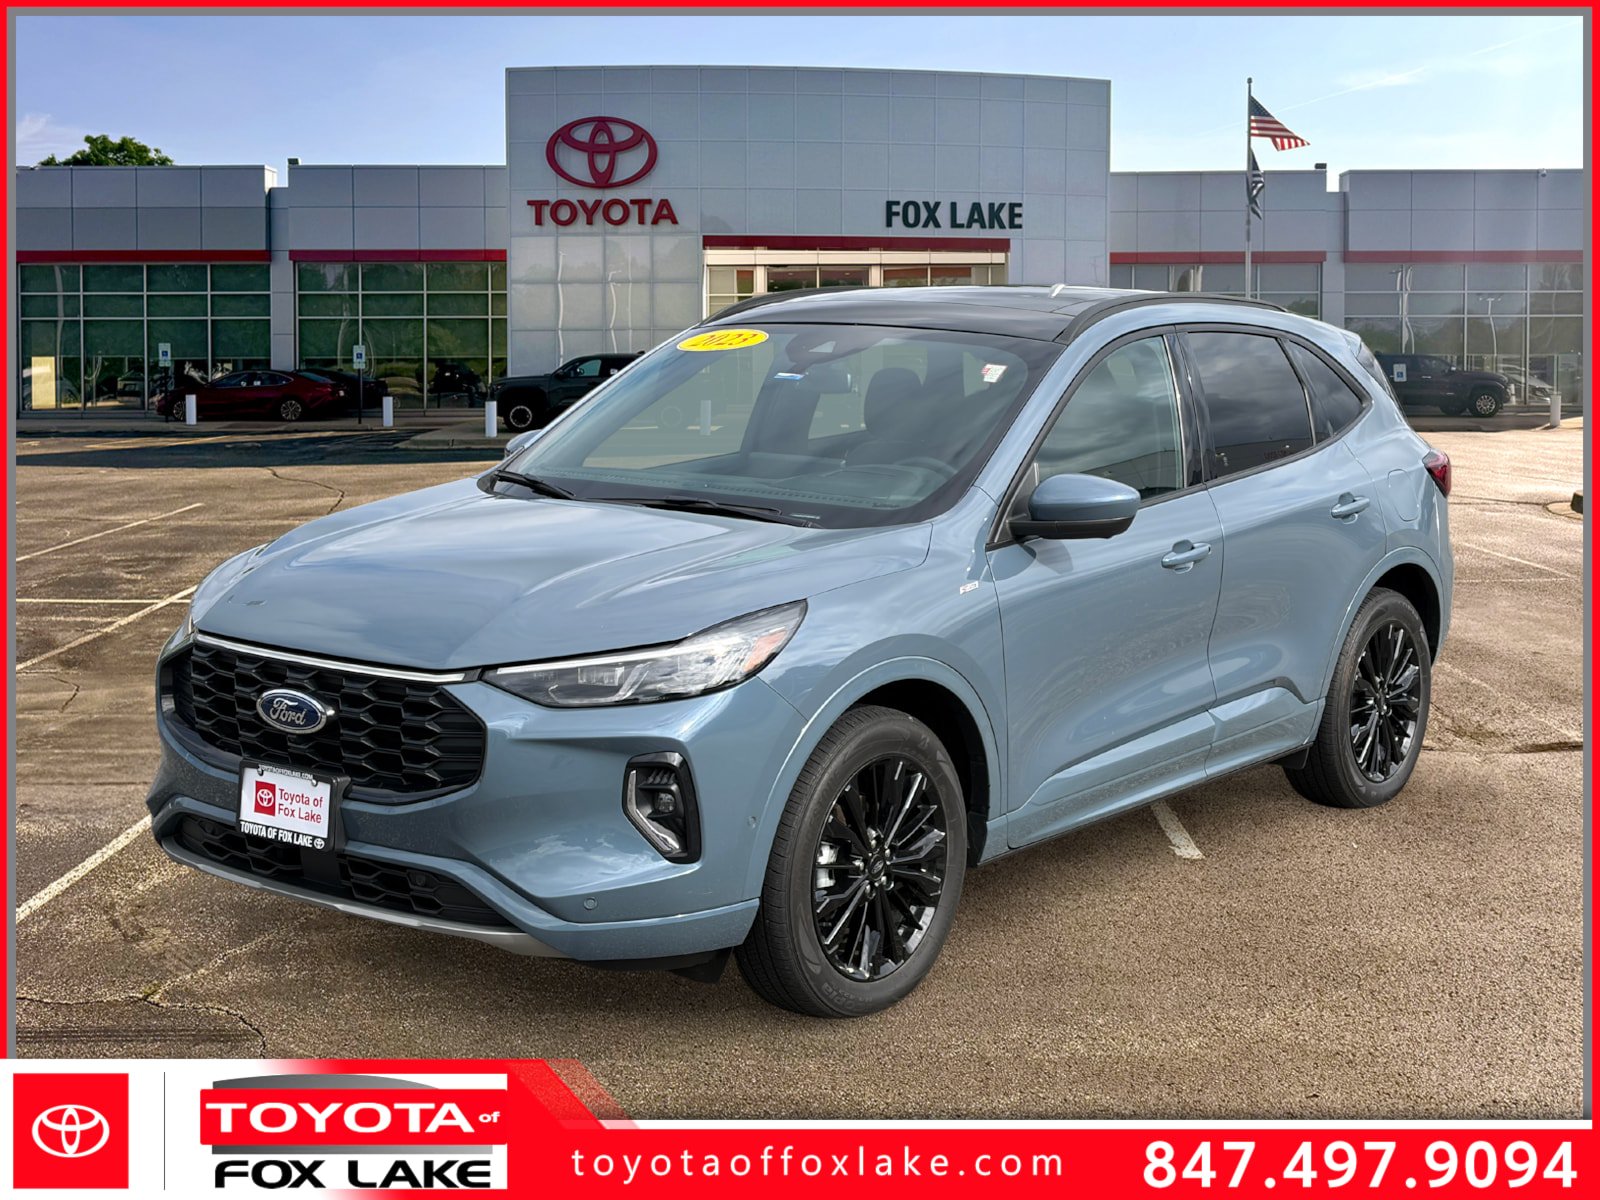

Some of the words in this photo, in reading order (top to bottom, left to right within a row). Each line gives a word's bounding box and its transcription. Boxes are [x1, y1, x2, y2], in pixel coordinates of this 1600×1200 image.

[527, 199, 679, 226] TOYOTA
[885, 200, 941, 229] FOX
[949, 202, 1023, 230] LAKE
[270, 697, 307, 725] Ford
[278, 788, 310, 805] Toyota
[312, 796, 323, 808] of
[277, 803, 296, 818] Fox
[298, 808, 322, 824] Lake
[240, 821, 267, 838] TOYOTA
[267, 827, 279, 840] OF
[278, 830, 293, 844] FOX
[293, 834, 313, 848] LAKE
